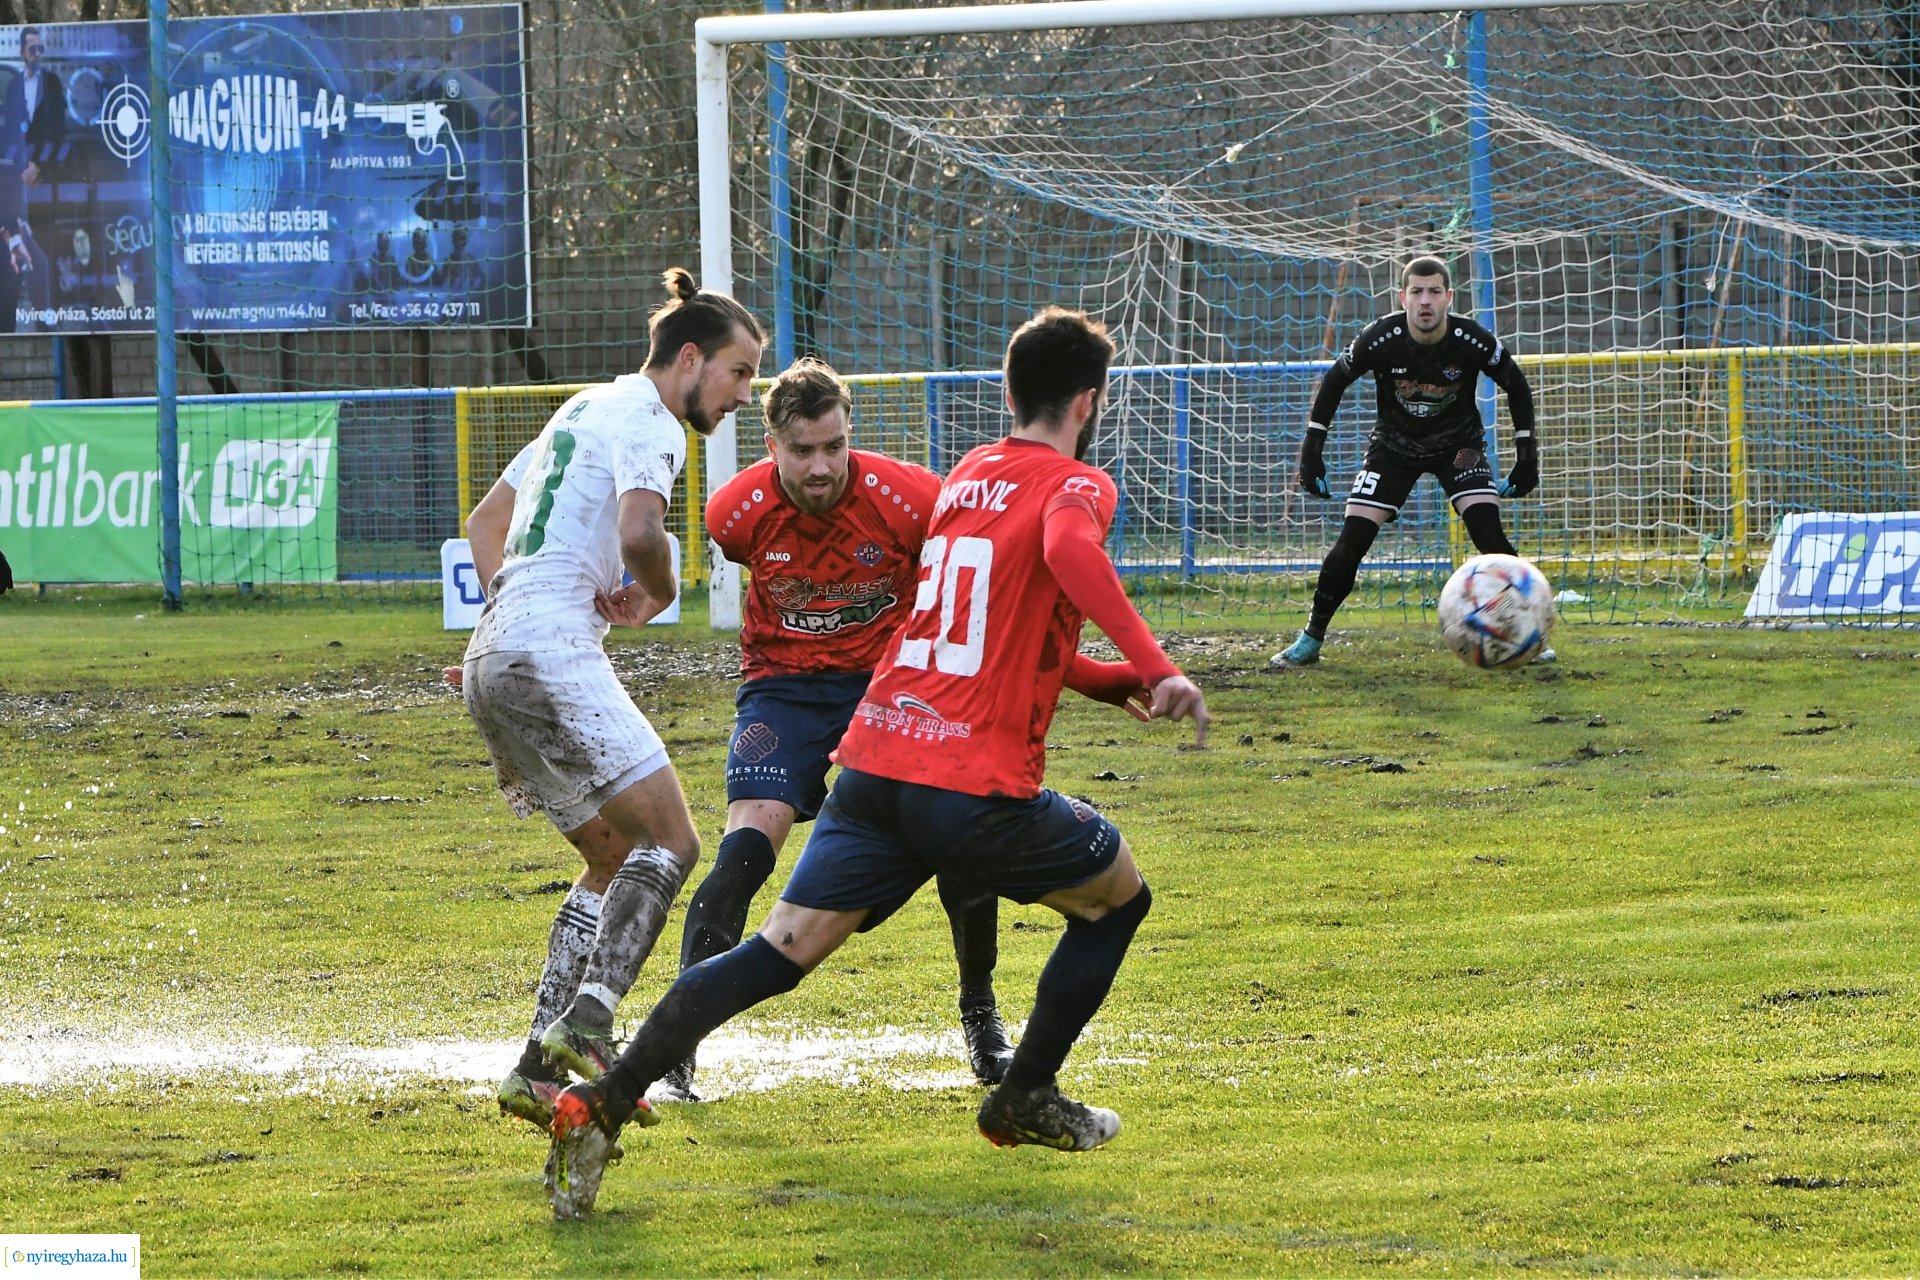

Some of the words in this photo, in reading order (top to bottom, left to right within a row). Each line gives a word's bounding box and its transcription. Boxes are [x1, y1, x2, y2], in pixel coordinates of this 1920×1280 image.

[168, 74, 348, 154] MAGNUM-44
[183, 214, 192, 234] A
[195, 208, 266, 233] BIZTONSÁG
[245, 243, 254, 263] A
[257, 236, 329, 263] BIZTONSÁG
[16, 307, 90, 325] Nyíregyháza,
[129, 306, 142, 320] út
[192, 303, 326, 322] www.magnum44.hu
[423, 302, 440, 317] 42
[441, 301, 464, 316] 437
[223, 457, 318, 508] LIGA
[1352, 470, 1381, 496] 95
[765, 551, 791, 562] JAKO
[893, 535, 994, 678] 20
[727, 766, 788, 777] RESTIGE
